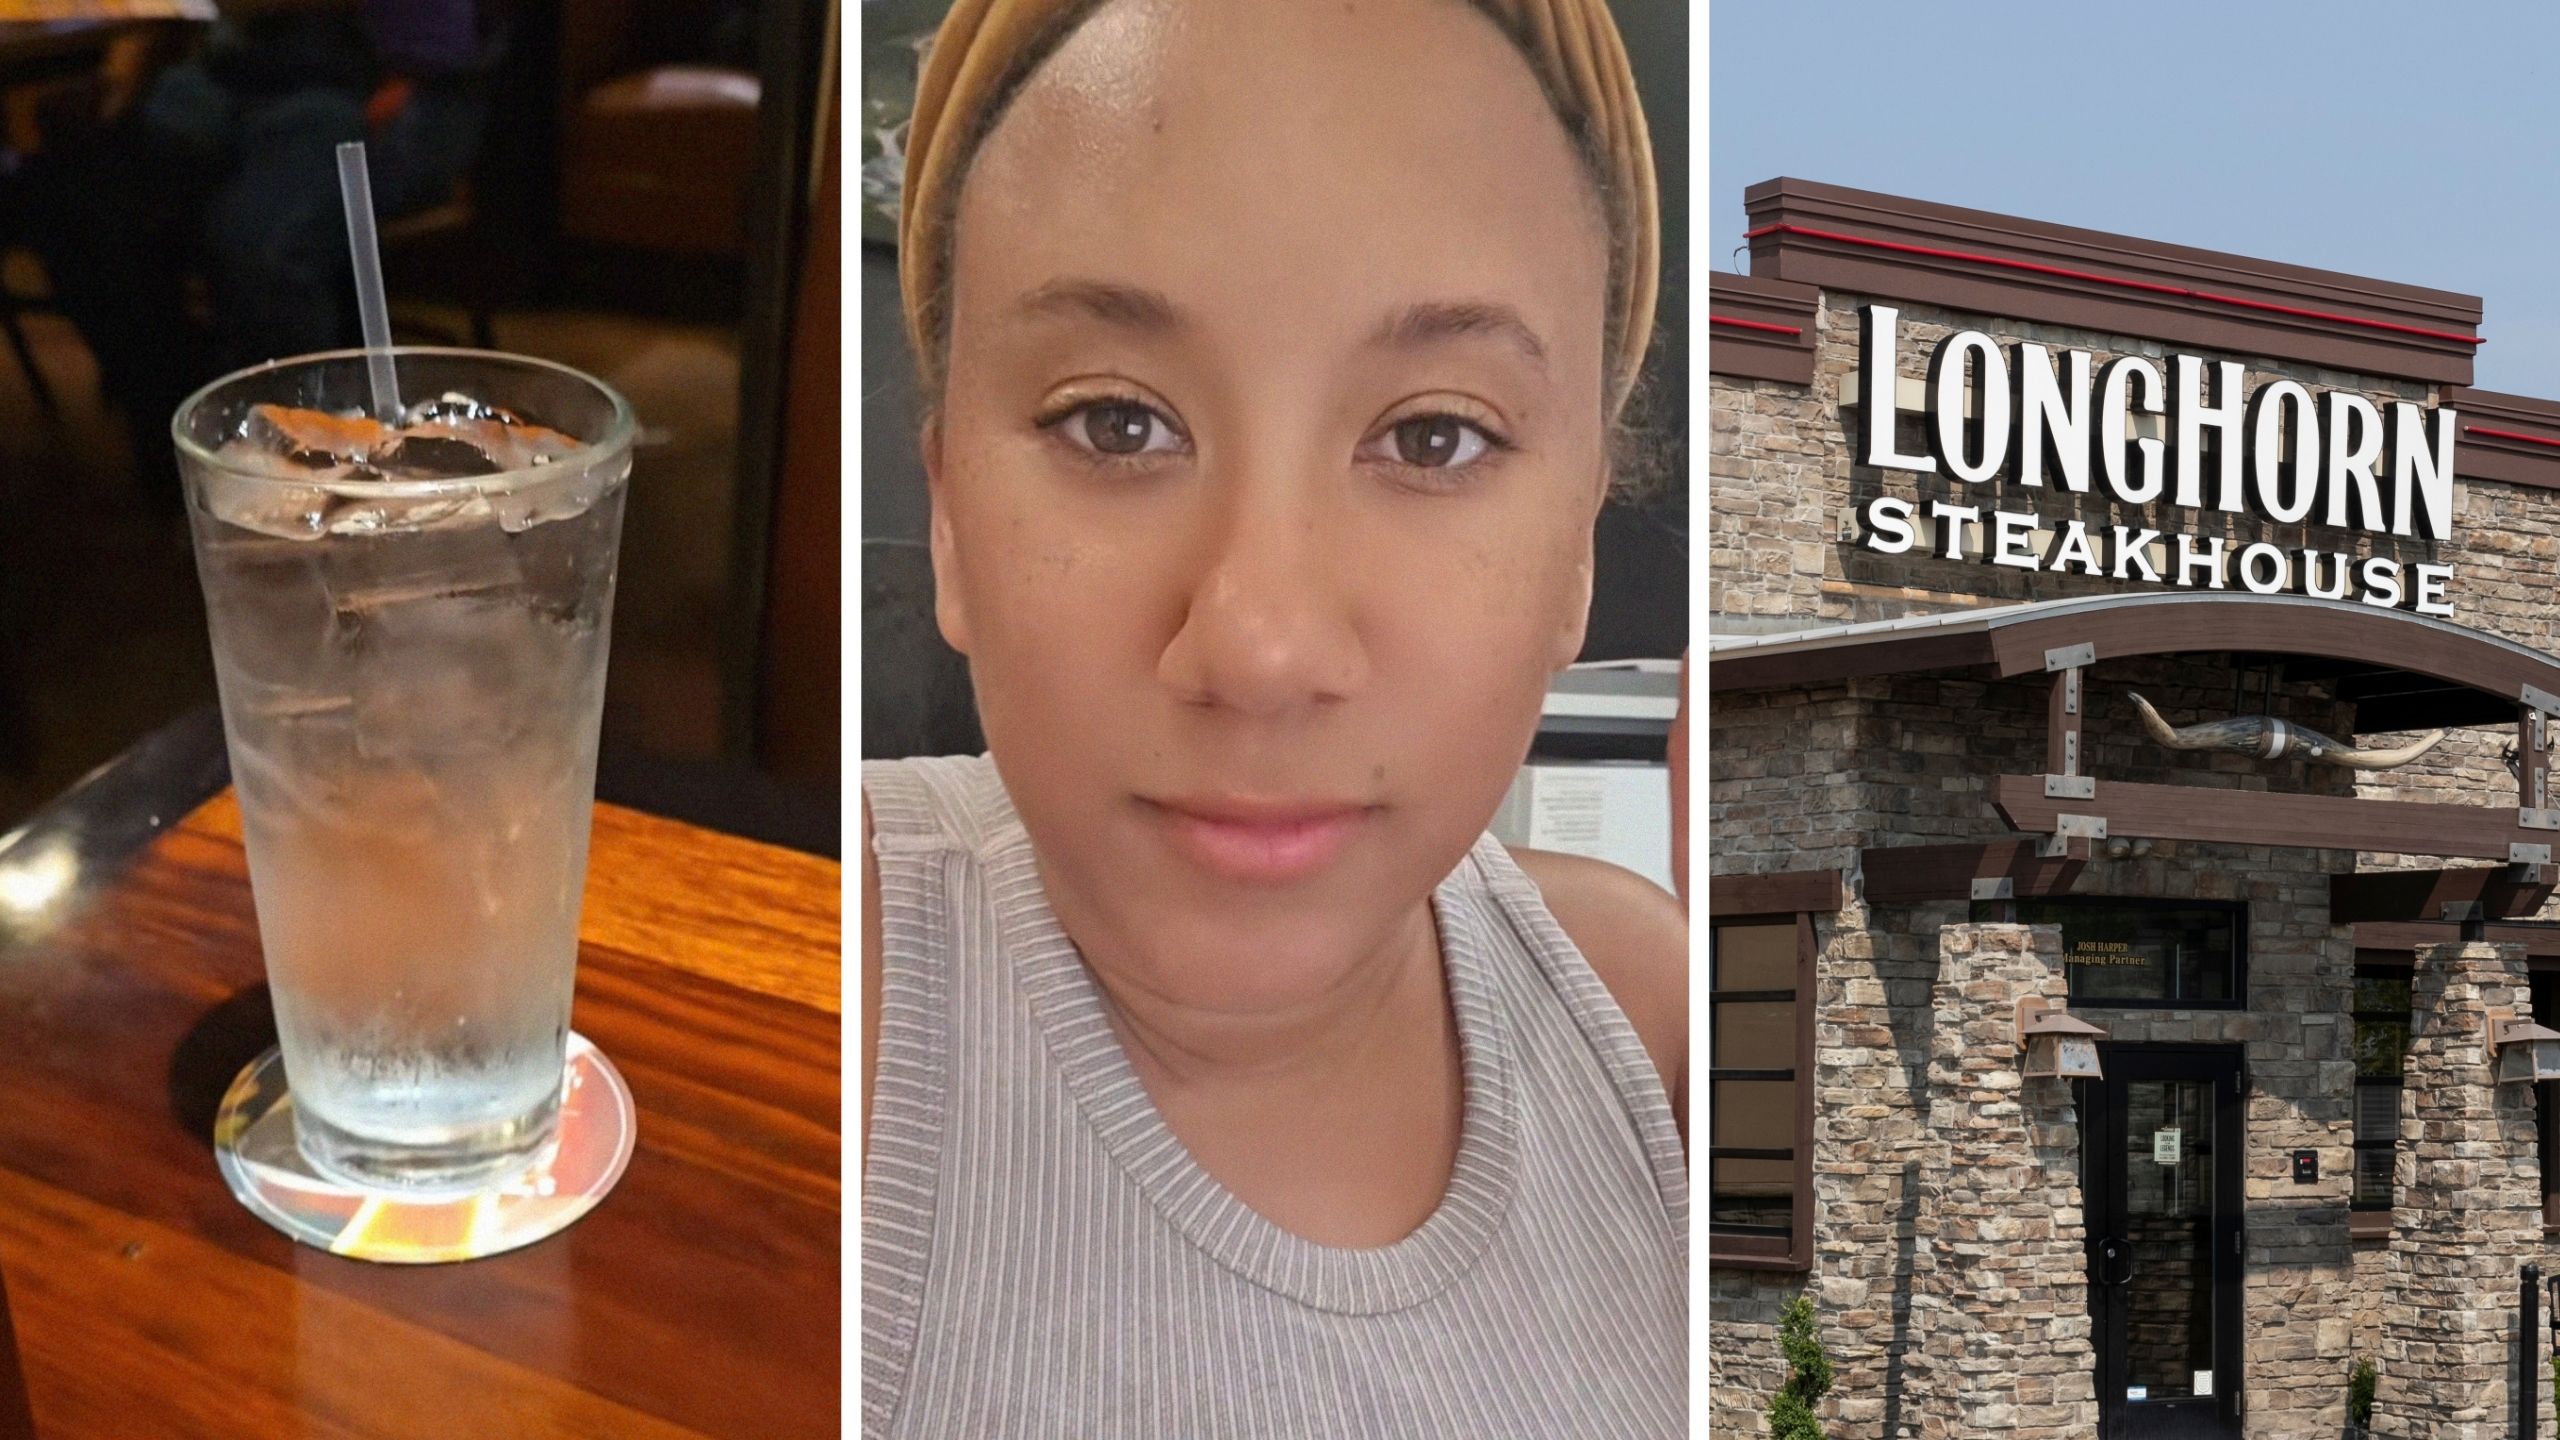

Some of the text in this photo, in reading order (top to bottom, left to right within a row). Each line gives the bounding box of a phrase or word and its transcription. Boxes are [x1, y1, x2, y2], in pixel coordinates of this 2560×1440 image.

[1861, 304, 2457, 541] LONGHORN
[1864, 496, 2455, 618] STEAKHOUSE
[2077, 941, 2128, 953] JOSH HARPER
[2109, 954, 2145, 965] Partner
